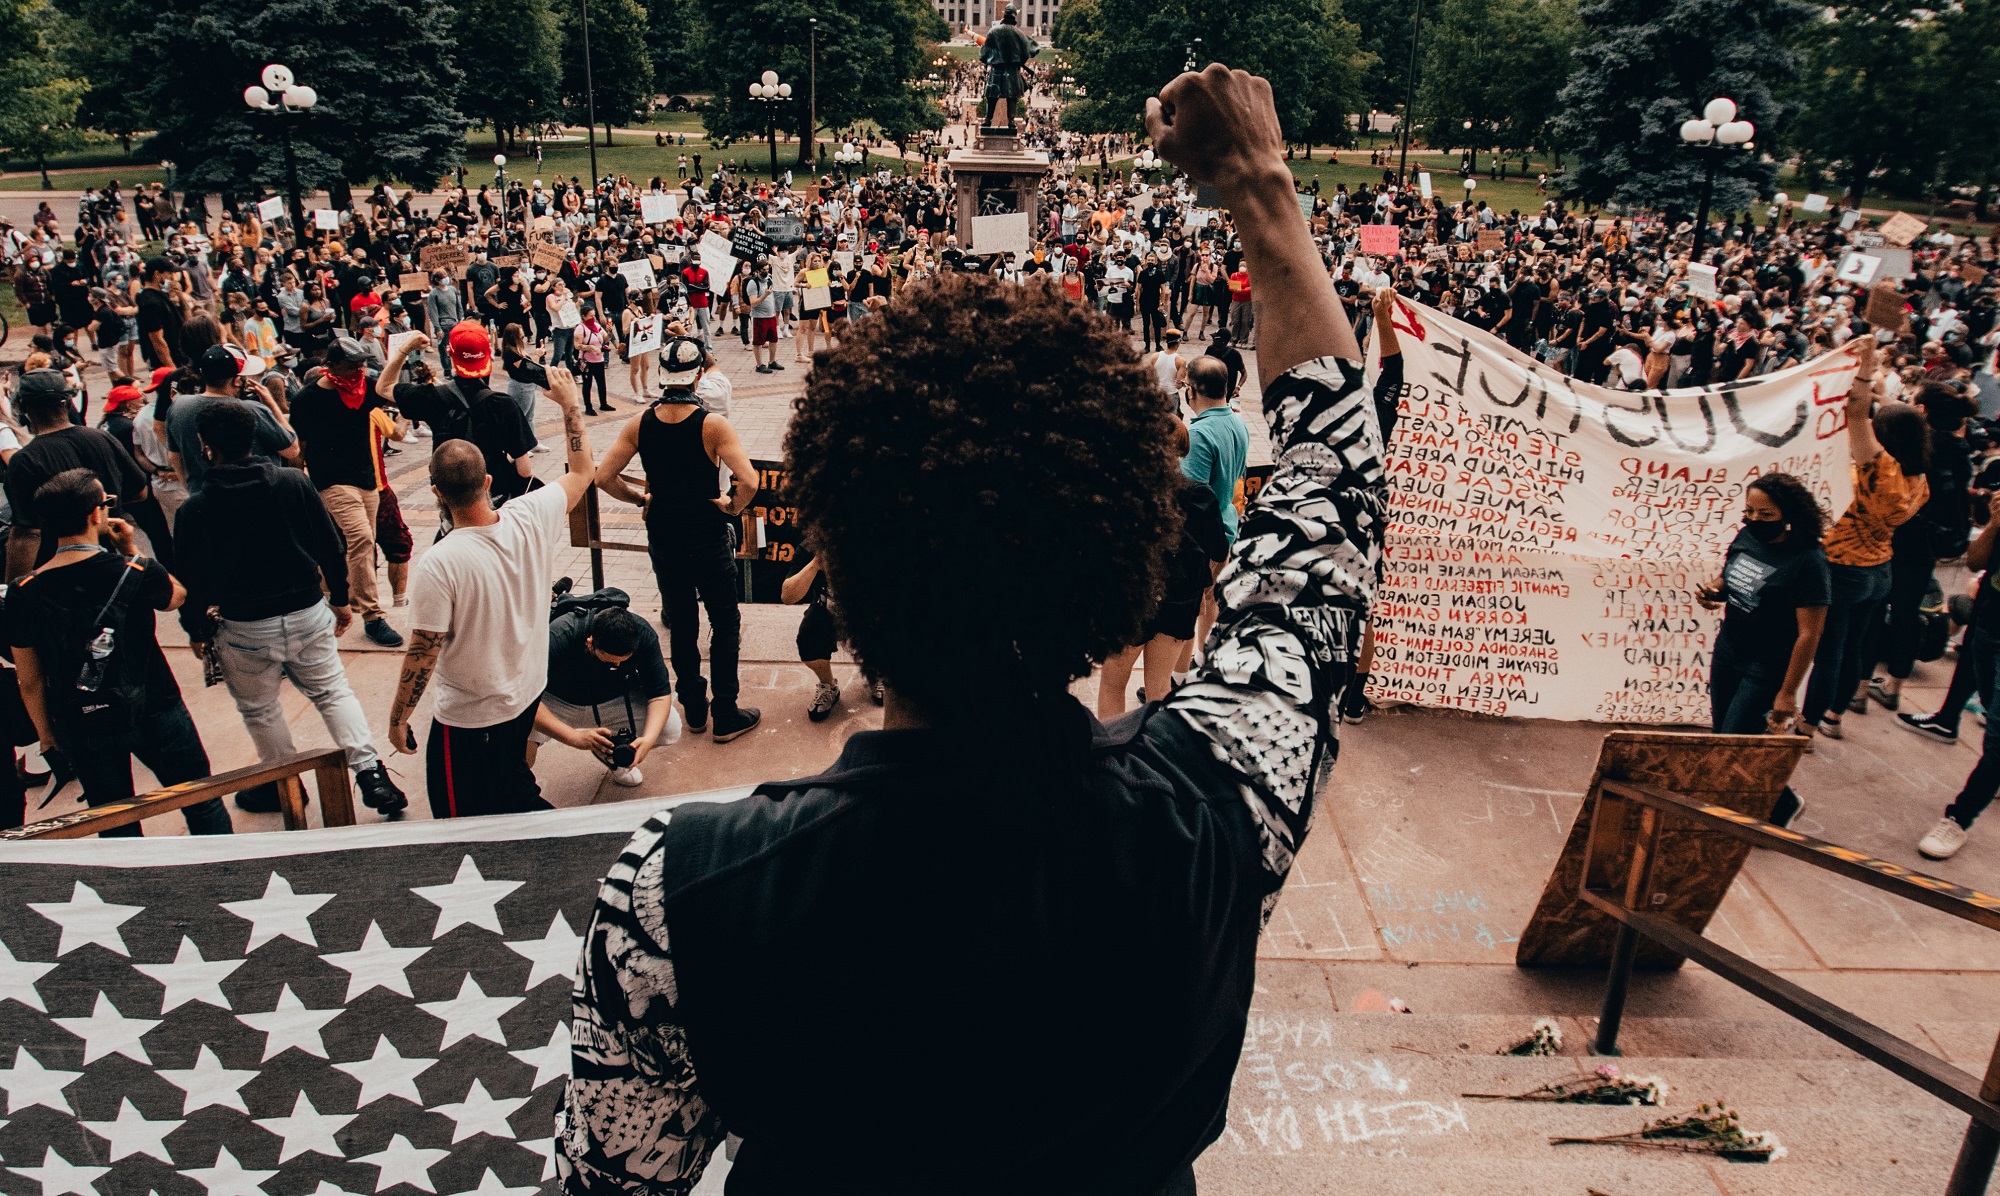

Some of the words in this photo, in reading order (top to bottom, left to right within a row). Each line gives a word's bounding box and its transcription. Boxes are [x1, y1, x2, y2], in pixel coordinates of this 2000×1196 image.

[1151, 213, 1161, 228] 4
[735, 233, 753, 243] MATTER
[754, 239, 768, 249] UNTIL
[747, 231, 761, 240] LIVES
[734, 238, 749, 247] BLACK
[751, 244, 764, 252] LIVES
[735, 244, 753, 255] MATTER
[429, 251, 465, 262] MURDERERS
[1739, 559, 1764, 573] NATIONAL
[1315, 1100, 1469, 1143] KEITH
